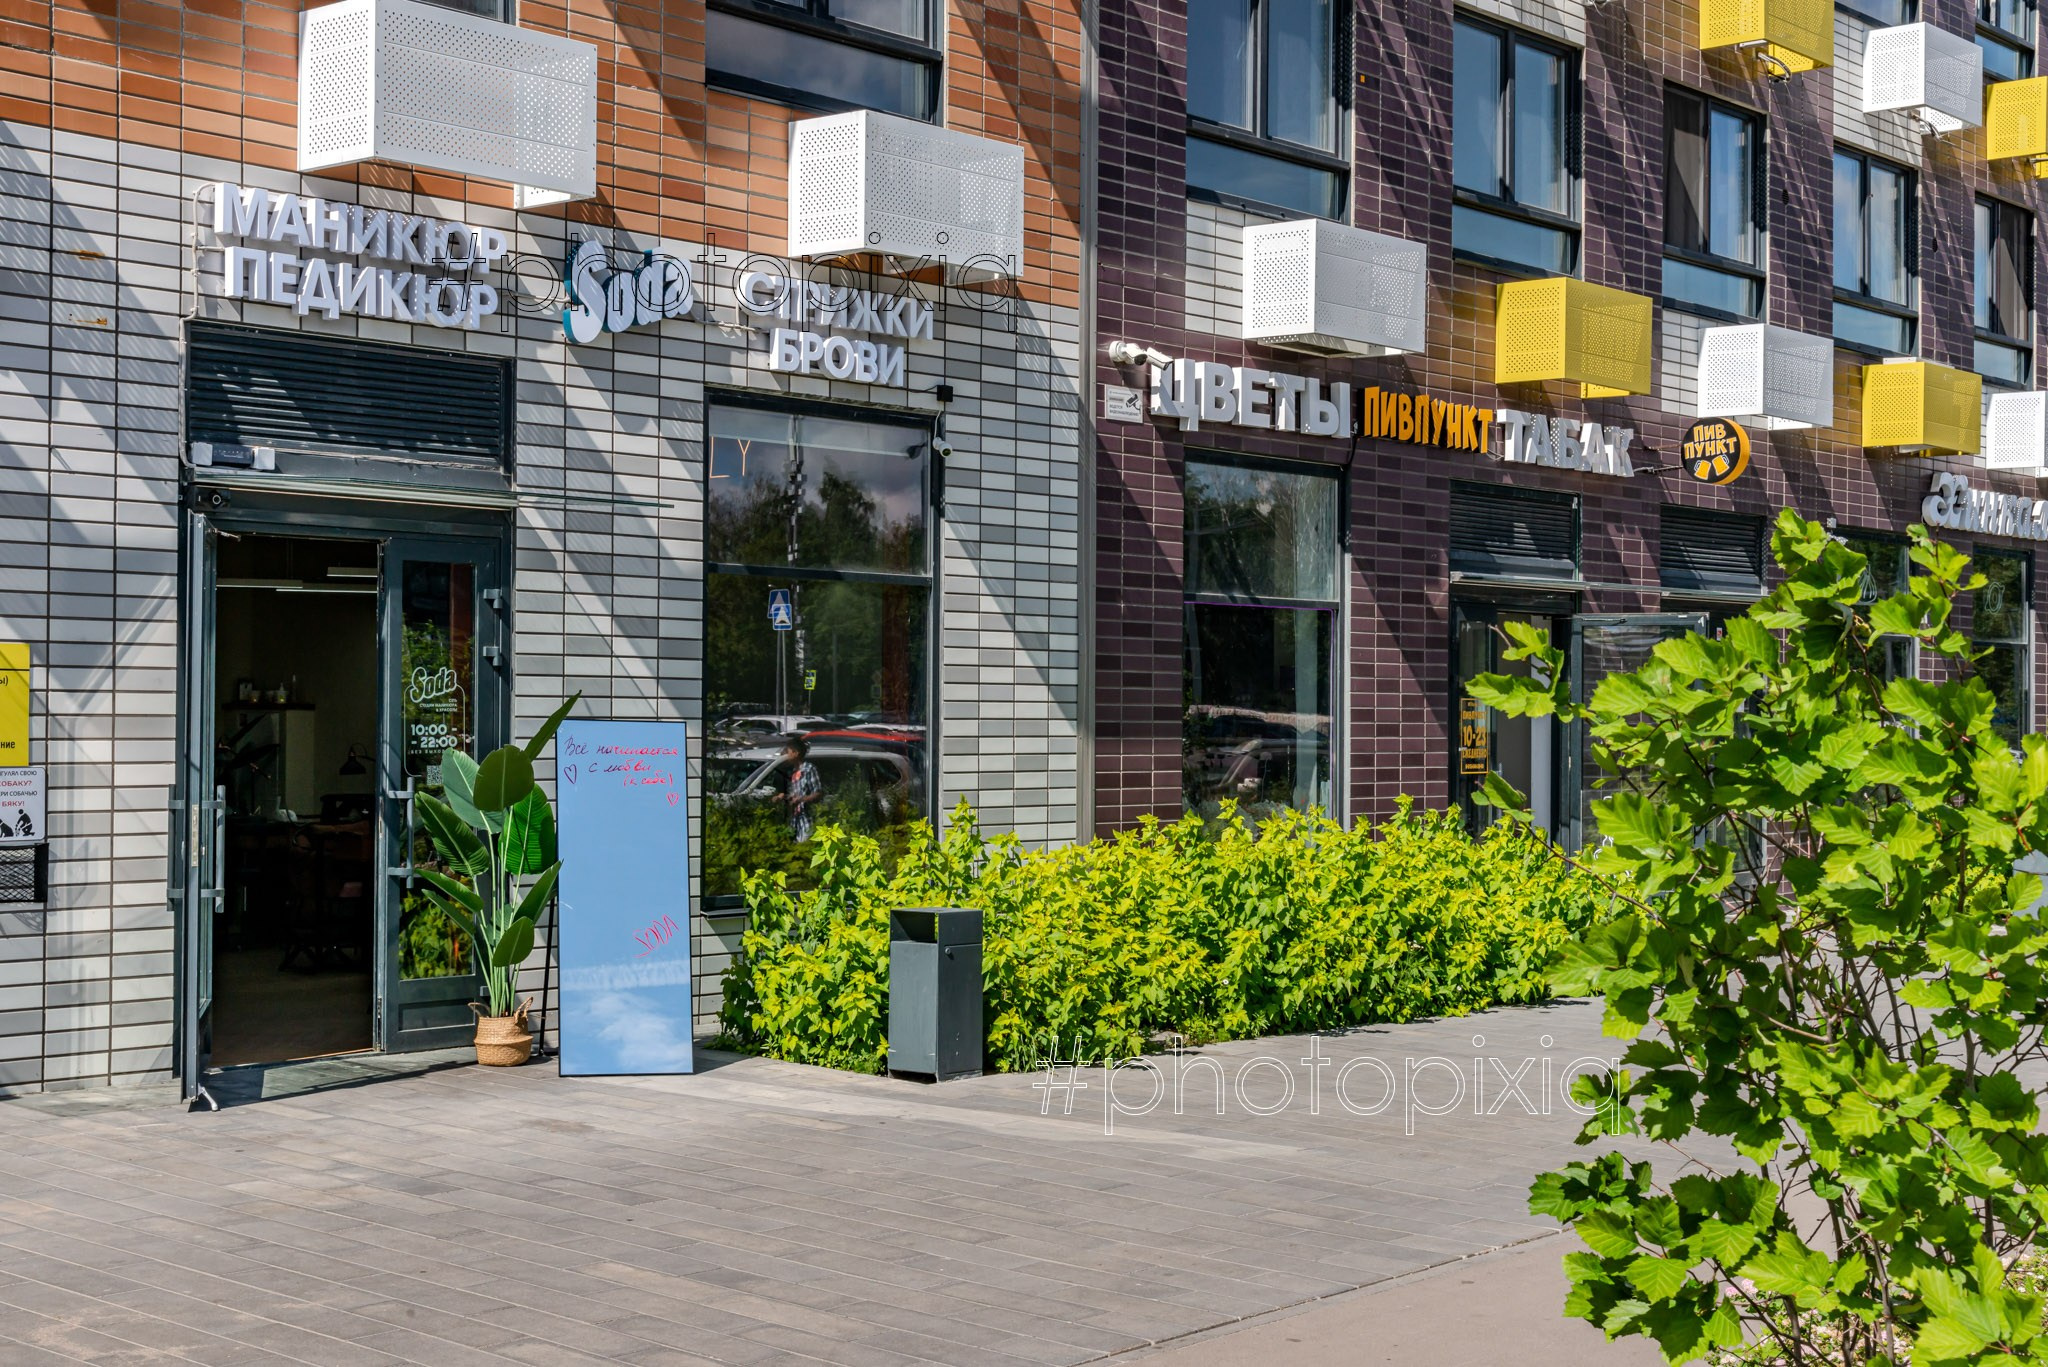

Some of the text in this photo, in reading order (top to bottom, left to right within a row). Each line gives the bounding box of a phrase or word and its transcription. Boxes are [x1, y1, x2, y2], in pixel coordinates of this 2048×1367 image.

[213, 182, 507, 274] МАНИКЮР
[224, 245, 499, 330] ПЕДИКЮР
[562, 240, 694, 344] Soda
[736, 271, 934, 341] СТРИЖКИ
[769, 327, 905, 388] БРОВИ
[1150, 358, 1351, 438] ЦВЕТЫ
[1363, 386, 1493, 454] ПИВПУНКТ
[1497, 408, 1635, 477] ТАБАК
[1683, 437, 1738, 459] ПУНКТ
[1693, 423, 1726, 442] ПИВ
[410, 666, 457, 703] Soda
[411, 724, 447, 736] 10:00
[420, 736, 458, 748] 22:00
